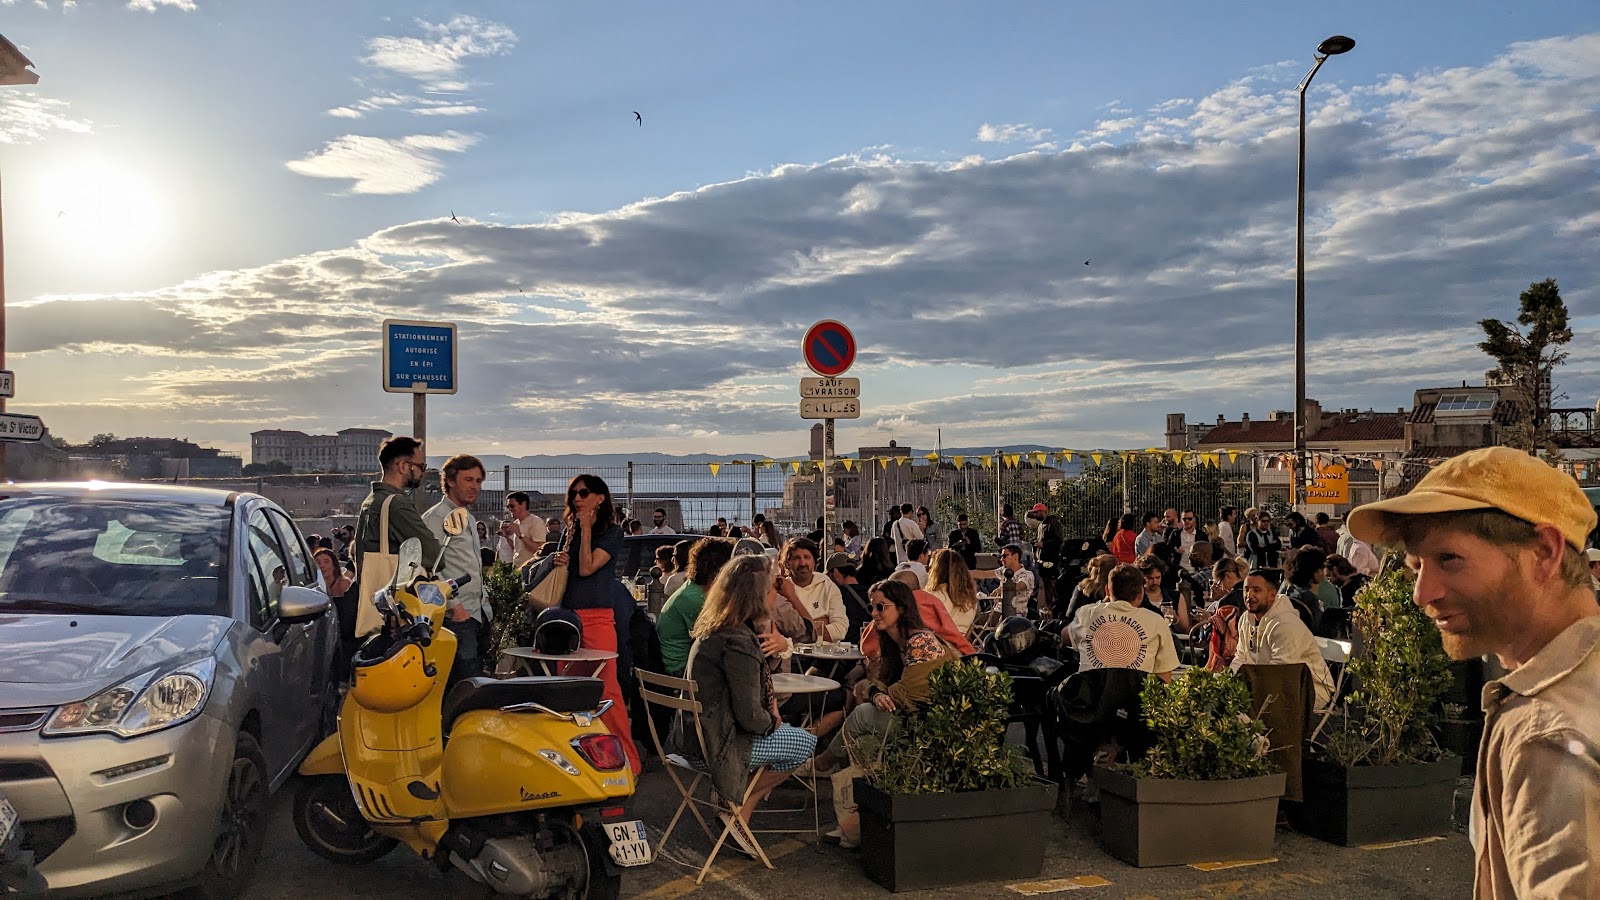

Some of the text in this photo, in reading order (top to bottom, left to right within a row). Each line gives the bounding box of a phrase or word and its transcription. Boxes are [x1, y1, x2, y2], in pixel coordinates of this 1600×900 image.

[394, 333, 448, 342] STATIONNEMENT
[819, 379, 842, 387] SAUF
[804, 388, 856, 396] IVRAISON
[18, 421, 39, 435] Victor
[1089, 615, 1107, 632] DEUS
[1108, 614, 1118, 622] EX
[1120, 616, 1148, 641] MACHINA
[1086, 634, 1104, 669] UBLISHING
[520, 786, 562, 801] Vespa
